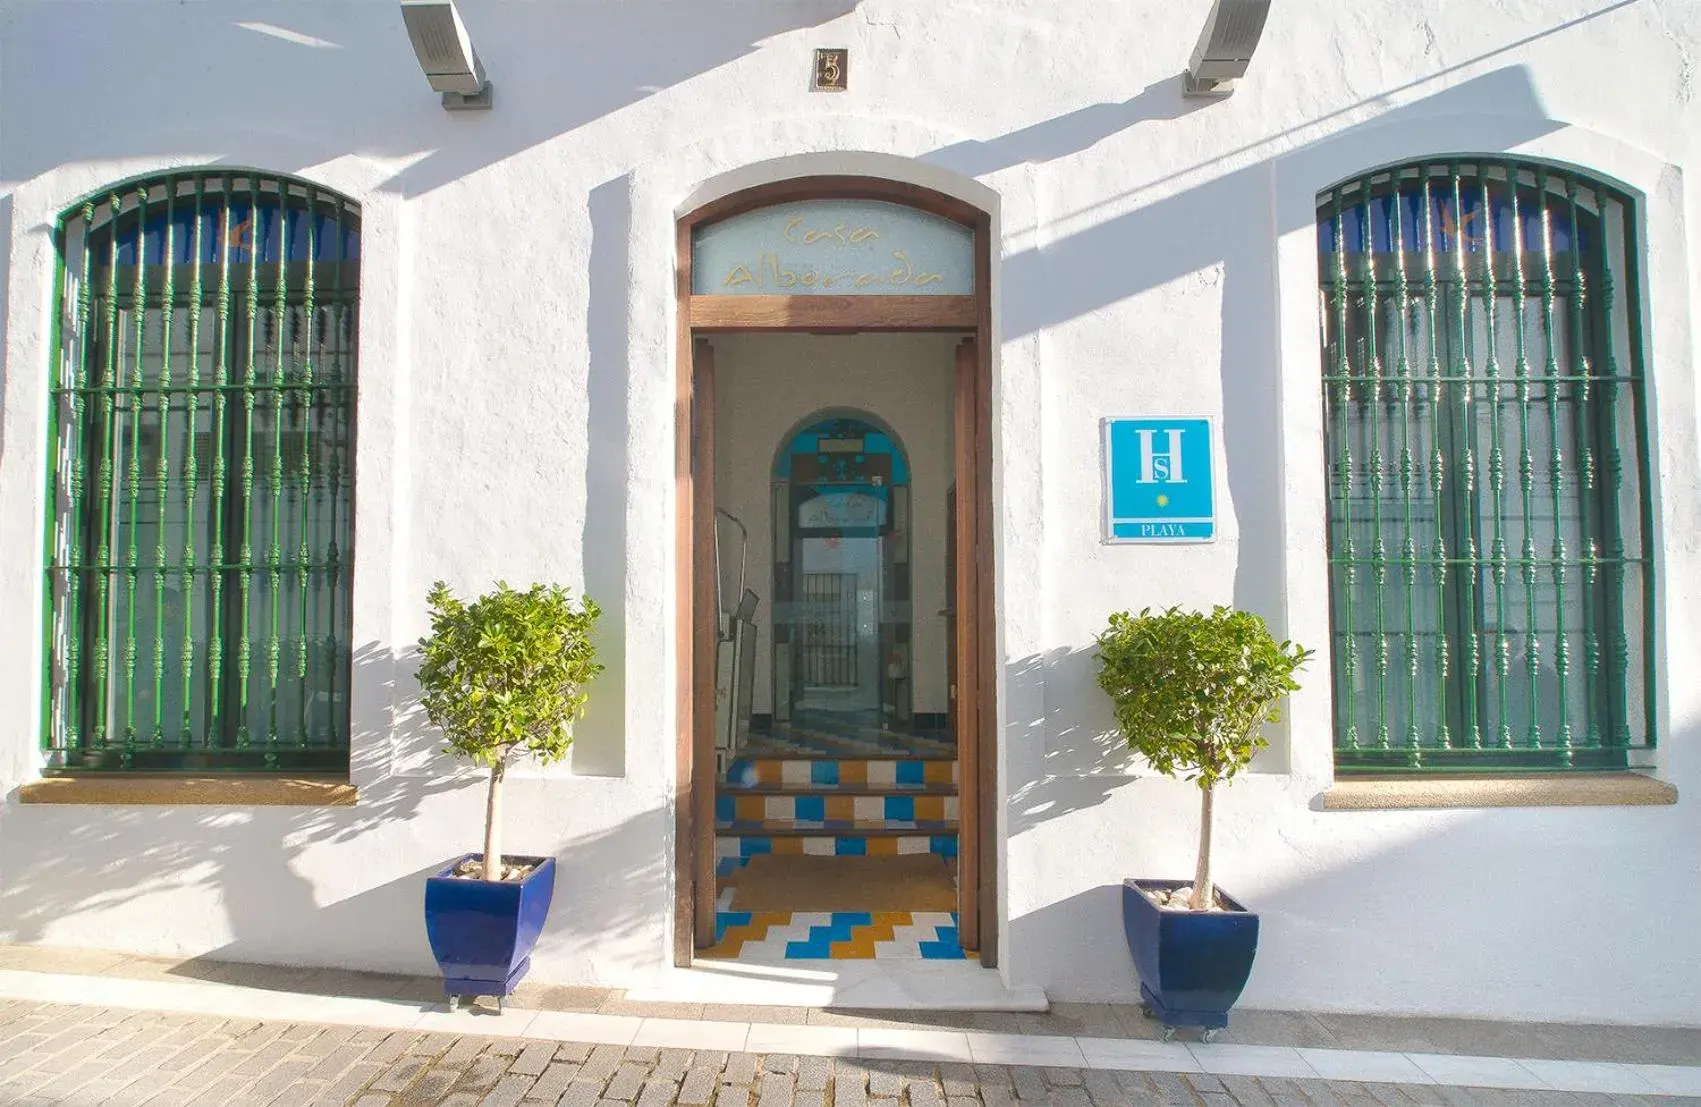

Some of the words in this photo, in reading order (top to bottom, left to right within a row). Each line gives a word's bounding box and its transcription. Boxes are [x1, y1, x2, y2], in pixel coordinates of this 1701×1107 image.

[784, 216, 879, 246] Casa
[723, 250, 942, 288] Alborada
[1141, 524, 1185, 536] PLAYA
